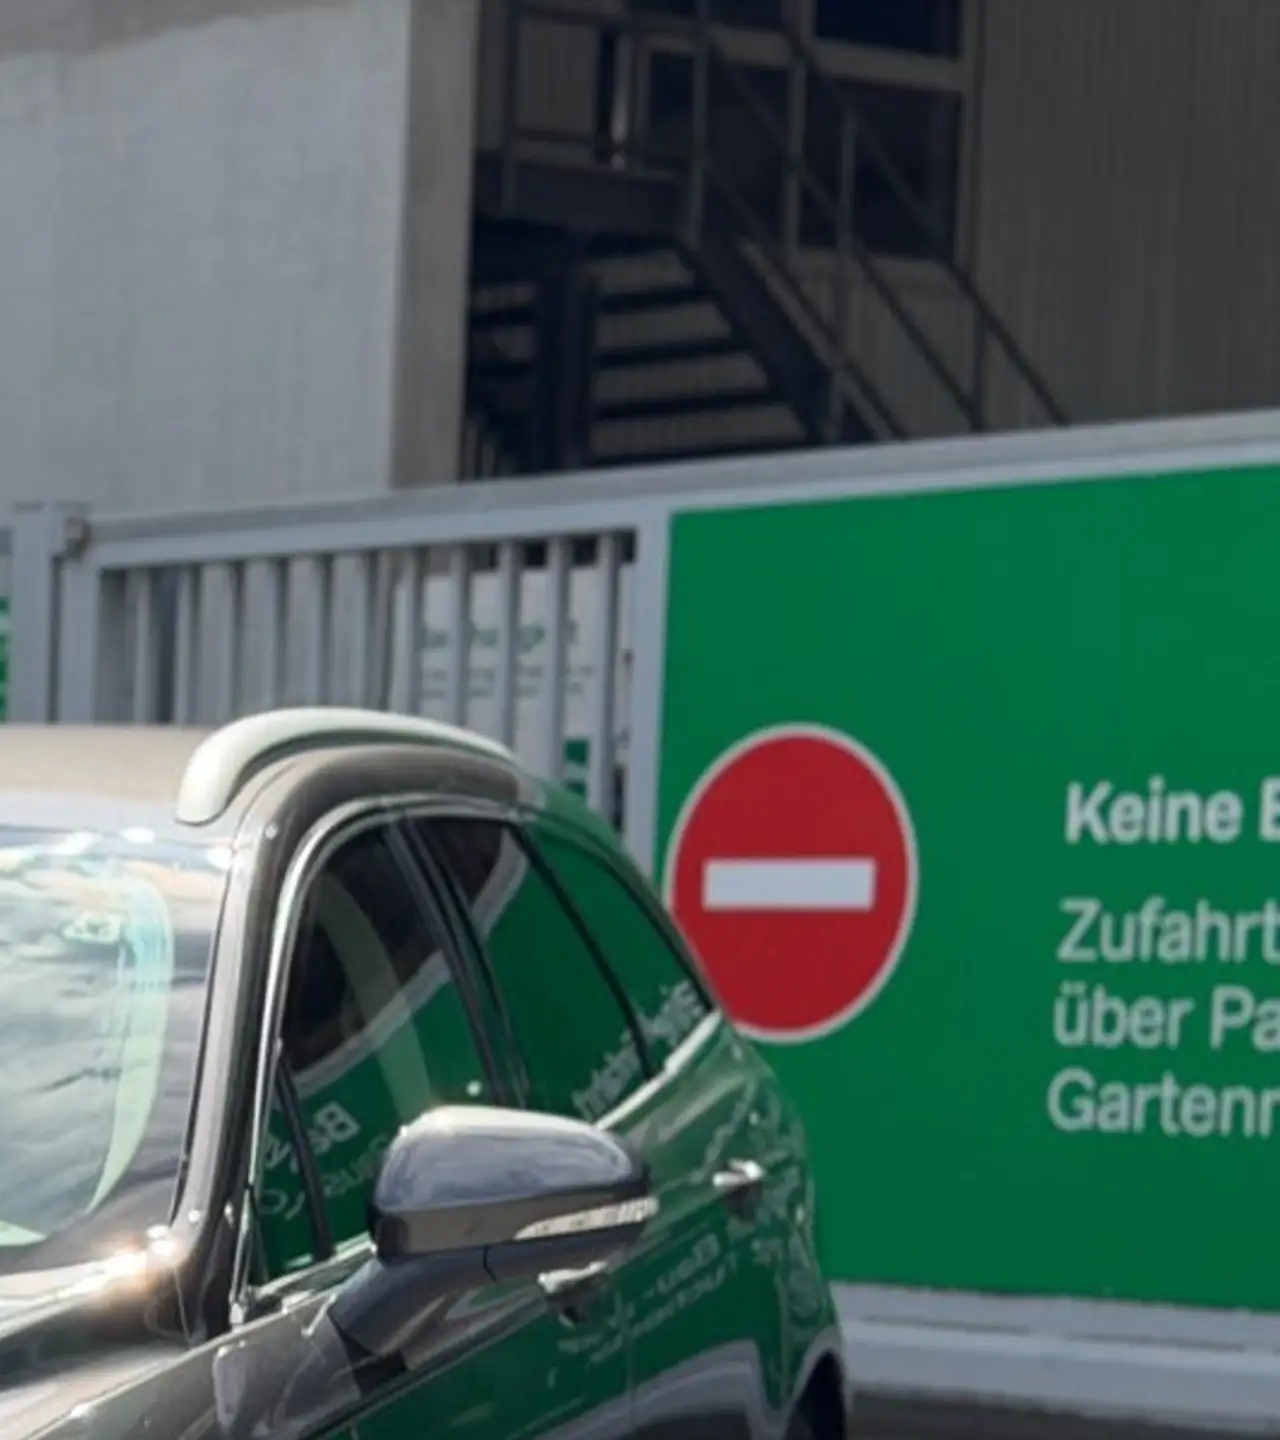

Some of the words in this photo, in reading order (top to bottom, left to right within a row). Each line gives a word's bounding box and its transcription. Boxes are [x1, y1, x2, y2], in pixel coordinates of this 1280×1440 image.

[1064, 773, 1244, 844] Keine
[1056, 894, 1280, 967] Zufahrt
[1052, 979, 1197, 1050] über
[1208, 982, 1280, 1053] Pa
